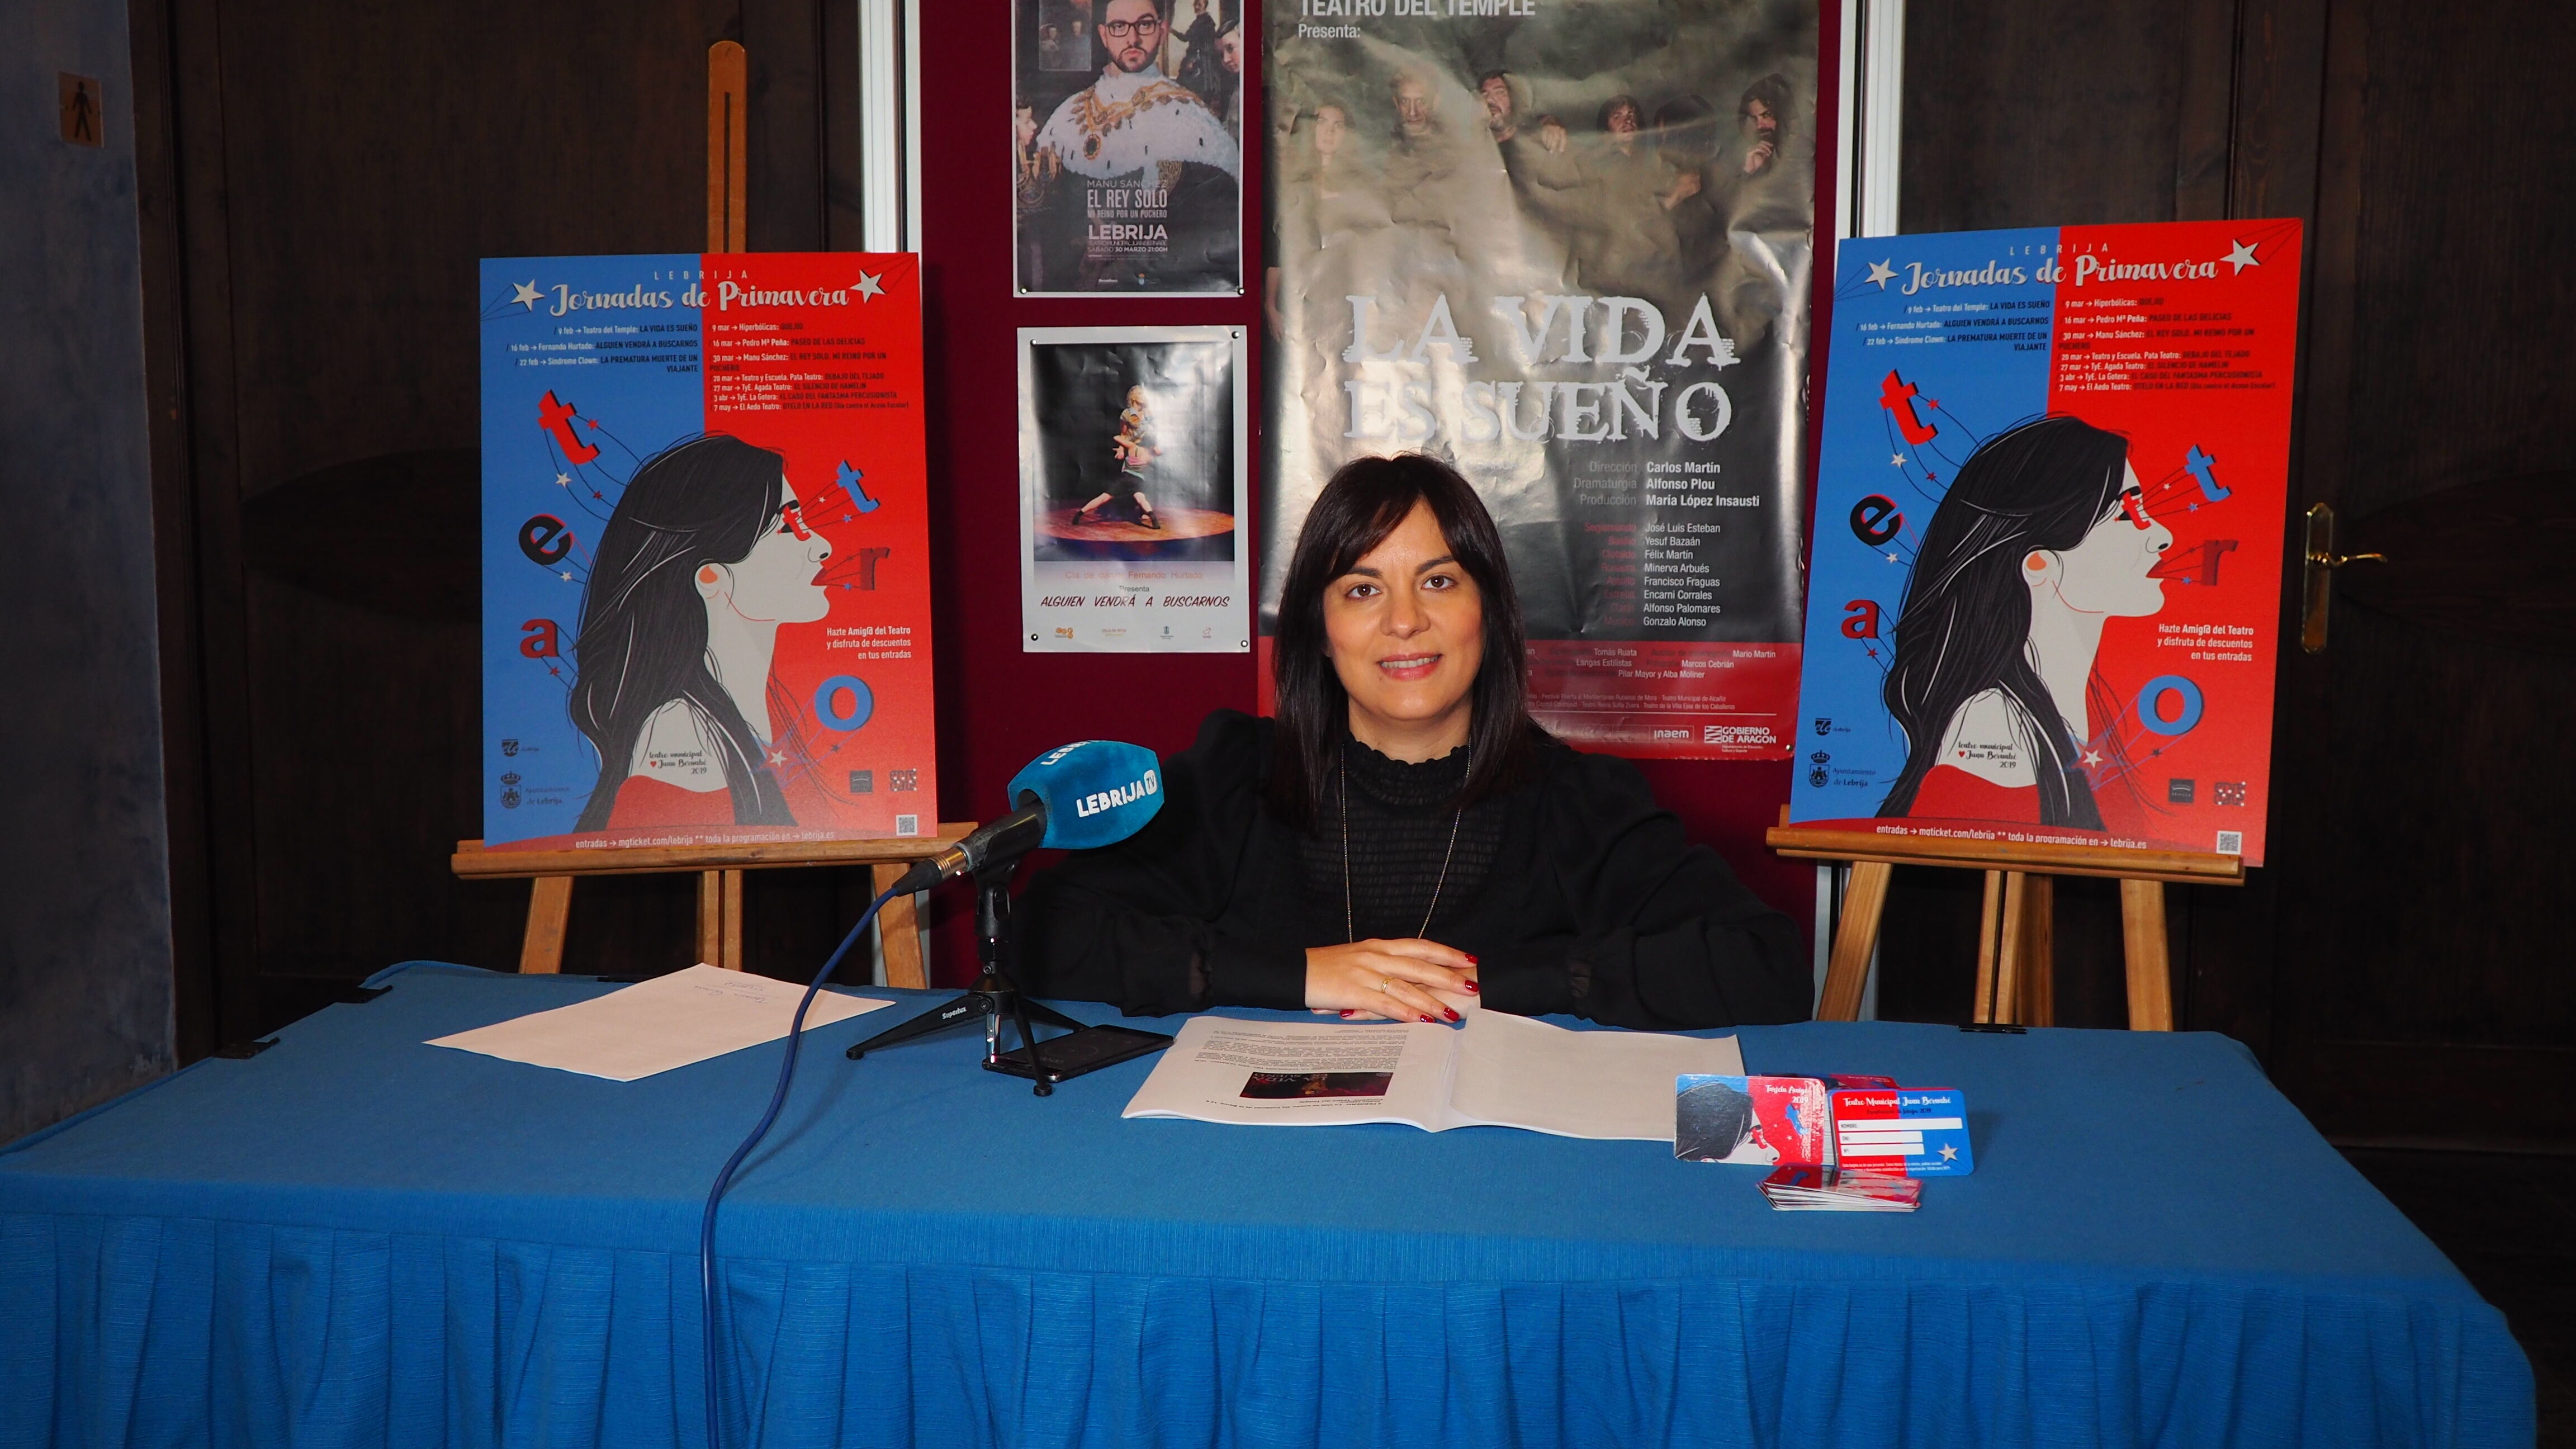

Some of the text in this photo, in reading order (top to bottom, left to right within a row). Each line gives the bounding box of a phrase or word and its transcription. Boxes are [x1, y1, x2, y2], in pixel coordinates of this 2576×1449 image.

[1301, 0, 1535, 16] TEATRO DEL TEMPLE
[1299, 23, 1360, 38] Presenta:
[1087, 190, 1167, 207] EL REY SOLO
[1088, 225, 1167, 239] LEBRIJA
[2010, 243, 2109, 255] LEBRIJA
[654, 271, 747, 280] LEBRIJA
[1901, 254, 2218, 295] Jornadas de Primavera
[550, 281, 849, 316] Jornadas de Primavera
[2094, 298, 2137, 307] Hiperbólicas:
[614, 326, 638, 335] Temple:
[676, 323, 697, 331] SUEÑO
[1343, 292, 1741, 368] LA VIDA
[1344, 365, 1732, 442] ES SUEÑO
[1590, 462, 1720, 473] Dirección Carlos Martín
[1647, 479, 1688, 490] Alfonso
[1691, 479, 1715, 490] Plou
[1580, 494, 1760, 508] Producción María López Insausti
[1646, 523, 1665, 532] José
[1668, 523, 1685, 532] Luis
[1687, 523, 1720, 533] Esteban
[1645, 537, 1668, 546] Yesuf
[1670, 537, 1700, 546] Bazaán
[1645, 550, 1664, 559] Félix
[1667, 550, 1693, 560] Martín
[1645, 564, 1678, 572] Minerva
[1680, 564, 1710, 573] Arbués
[1645, 577, 1684, 586] Francisco
[1687, 577, 1720, 588] Fraguas
[1644, 590, 1675, 599] Encarni
[1678, 590, 1712, 600] Corrales
[1041, 595, 1230, 607] ALGUIEN VENDRÁ A BUSCARNOS
[1644, 604, 1674, 612] Alfonso
[1677, 604, 1720, 613] Palomares
[1644, 617, 1677, 626] Gonzalo
[1678, 617, 1706, 626] Alonso
[2159, 624, 2180, 633] Hazte
[2213, 625, 2225, 634] del
[2228, 626, 2253, 635] Teatro
[833, 640, 860, 648] disfruta
[2157, 637, 2253, 648] y disfruta de descuentos
[1594, 647, 1616, 656] Tomás
[2218, 652, 2252, 661] entradas
[1577, 659, 1600, 667] Langas
[1603, 659, 1632, 667] Estilistas
[1708, 660, 1734, 668] Cebrián
[1635, 670, 1656, 680] Mayor
[1680, 670, 1704, 679] Moliner
[1654, 730, 1689, 739] inaem
[1076, 780, 1145, 817] LEBRIJA
[576, 839, 607, 849] entradas
[618, 835, 693, 848] mgticket.com/lebrija
[732, 833, 780, 844] programación
[1877, 826, 1907, 835] entradas
[2009, 832, 2024, 841] toda
[2026, 833, 2034, 842] la
[2035, 834, 2087, 845] programación
[2111, 838, 2147, 849] lebrija.es
[1764, 1085, 1787, 1094] Tarjeta
[1843, 1096, 1951, 1107] Teatro Municipal Juan Bernabé
